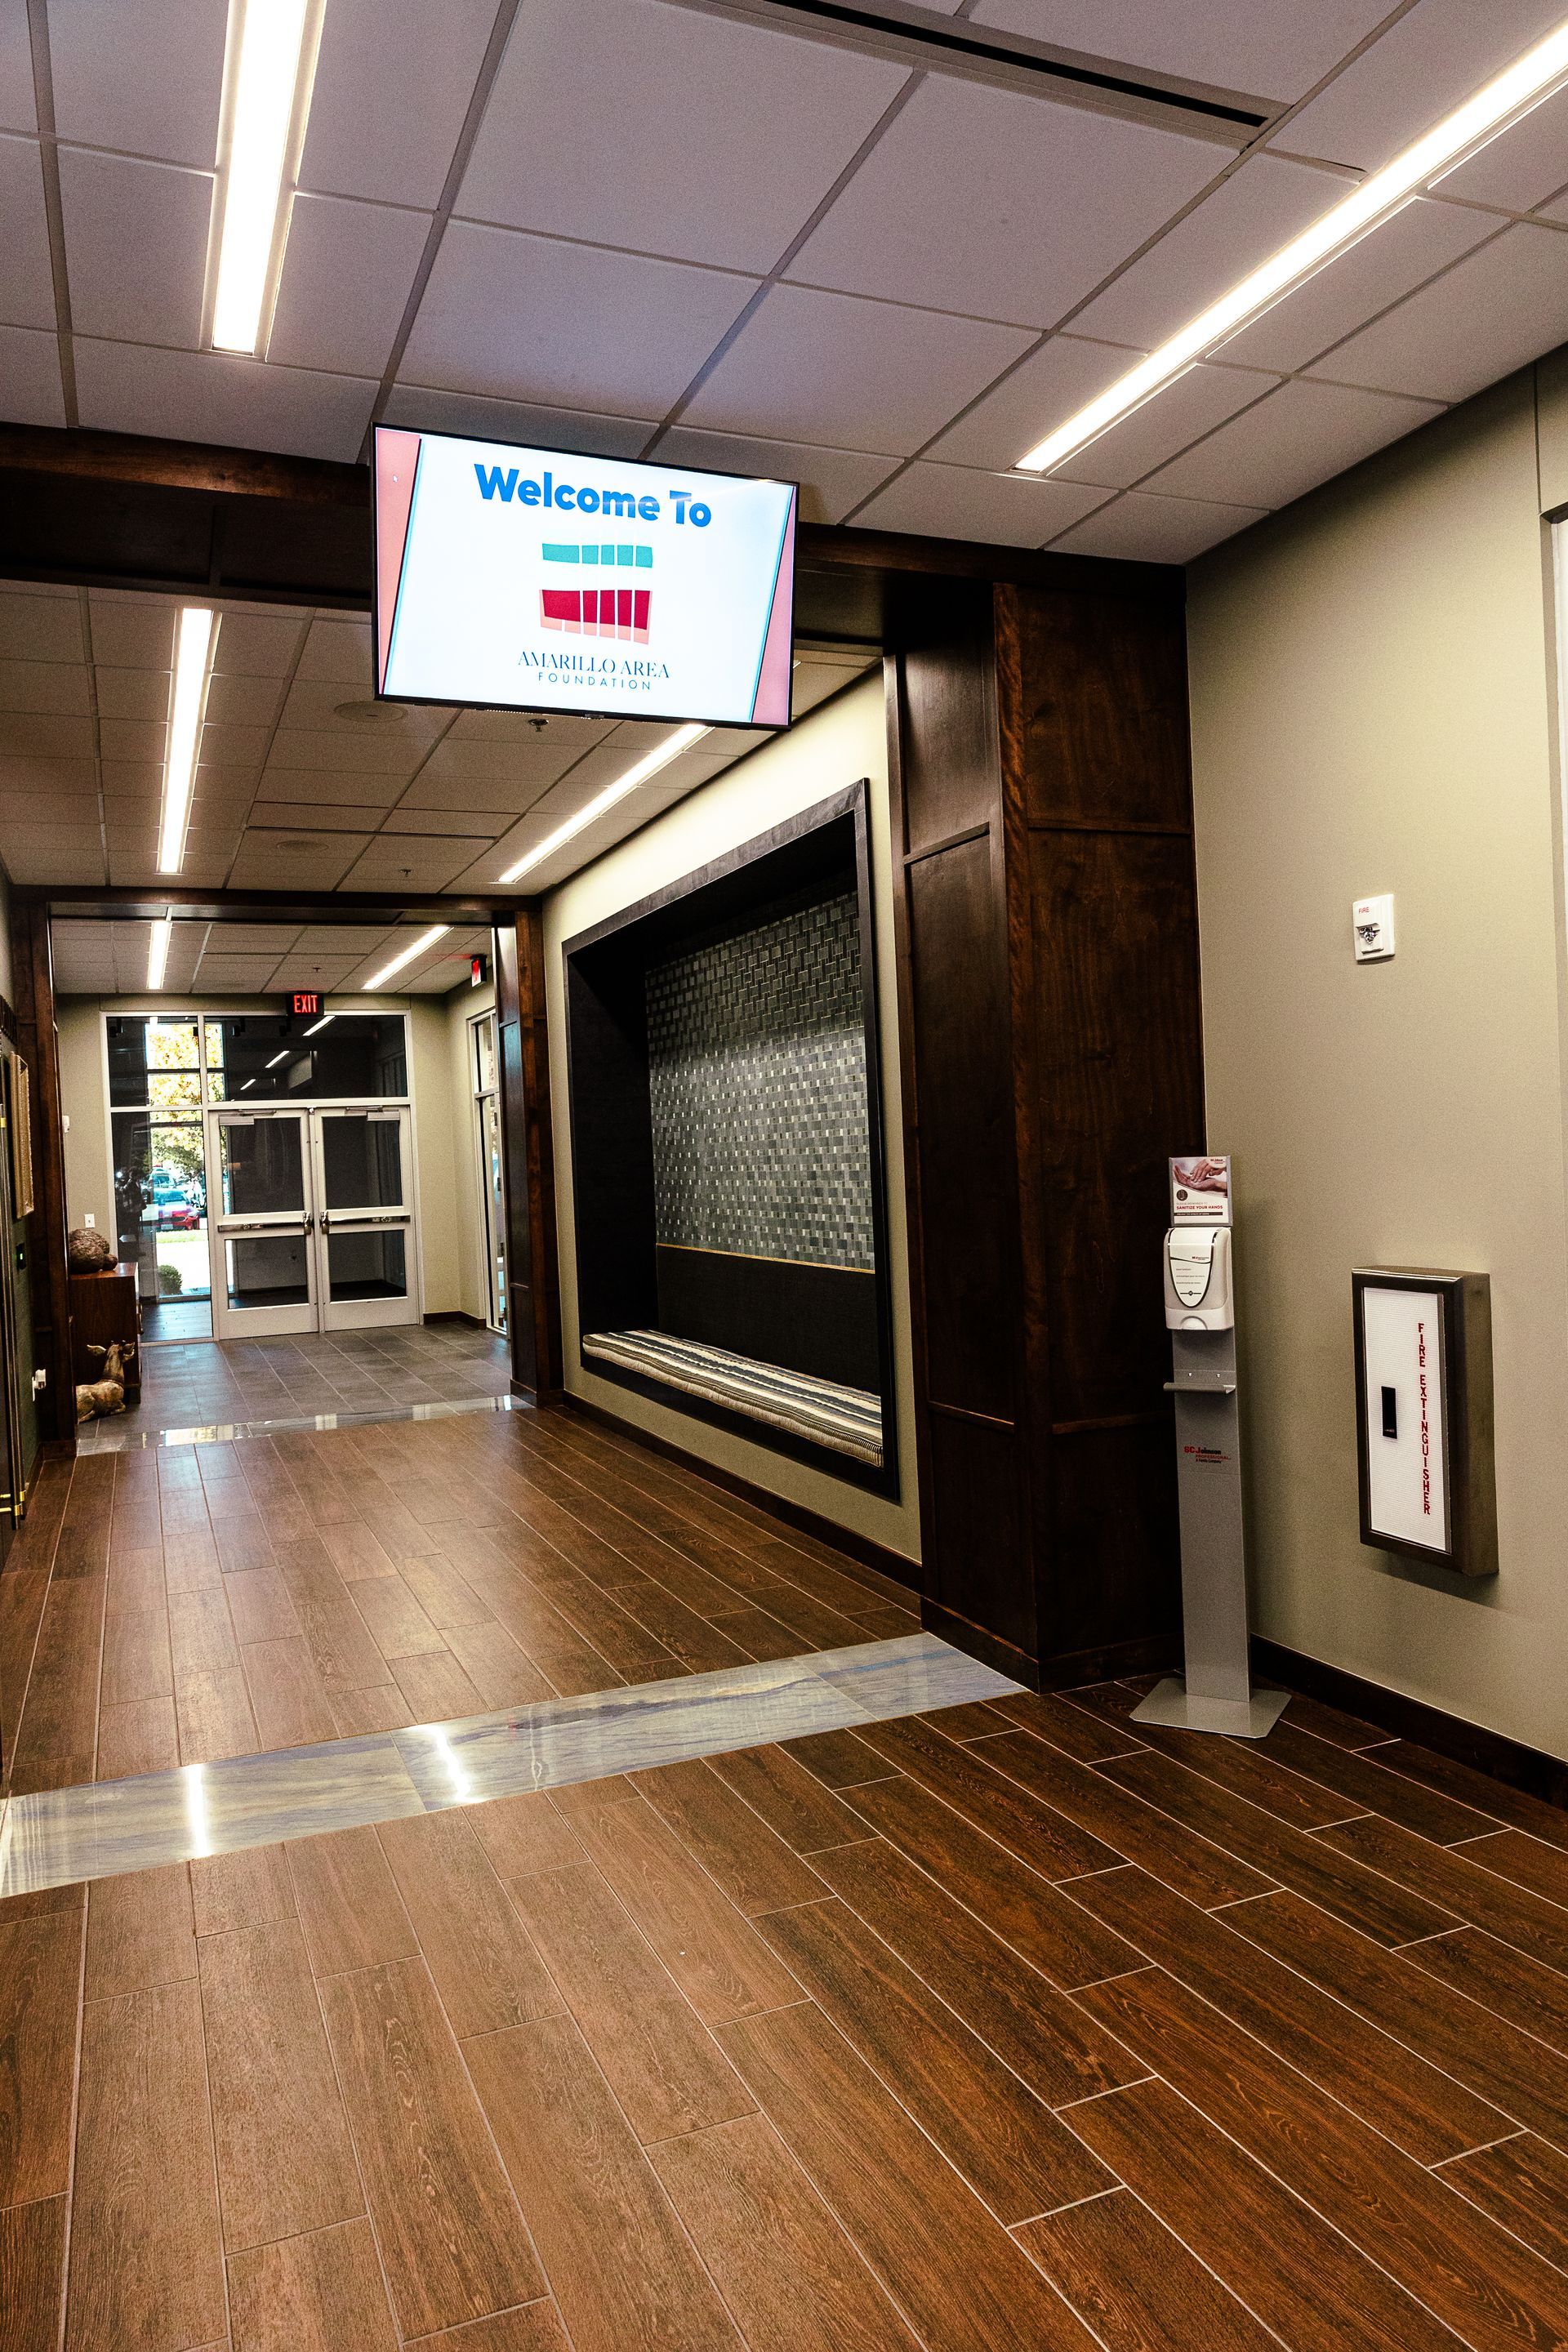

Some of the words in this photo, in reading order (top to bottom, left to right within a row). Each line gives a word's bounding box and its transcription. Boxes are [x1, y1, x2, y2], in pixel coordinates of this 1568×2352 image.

[474, 463, 661, 521] Welcome
[669, 489, 712, 528] To
[518, 651, 617, 674] AMARILLO
[620, 660, 670, 679] AREA
[538, 671, 651, 690] FOUNDATION
[1358, 906, 1370, 915] FIRE
[294, 995, 318, 1013] EXIT
[1418, 1322, 1426, 1368] FIRE
[1419, 1374, 1431, 1516] EXTINGUISHER
